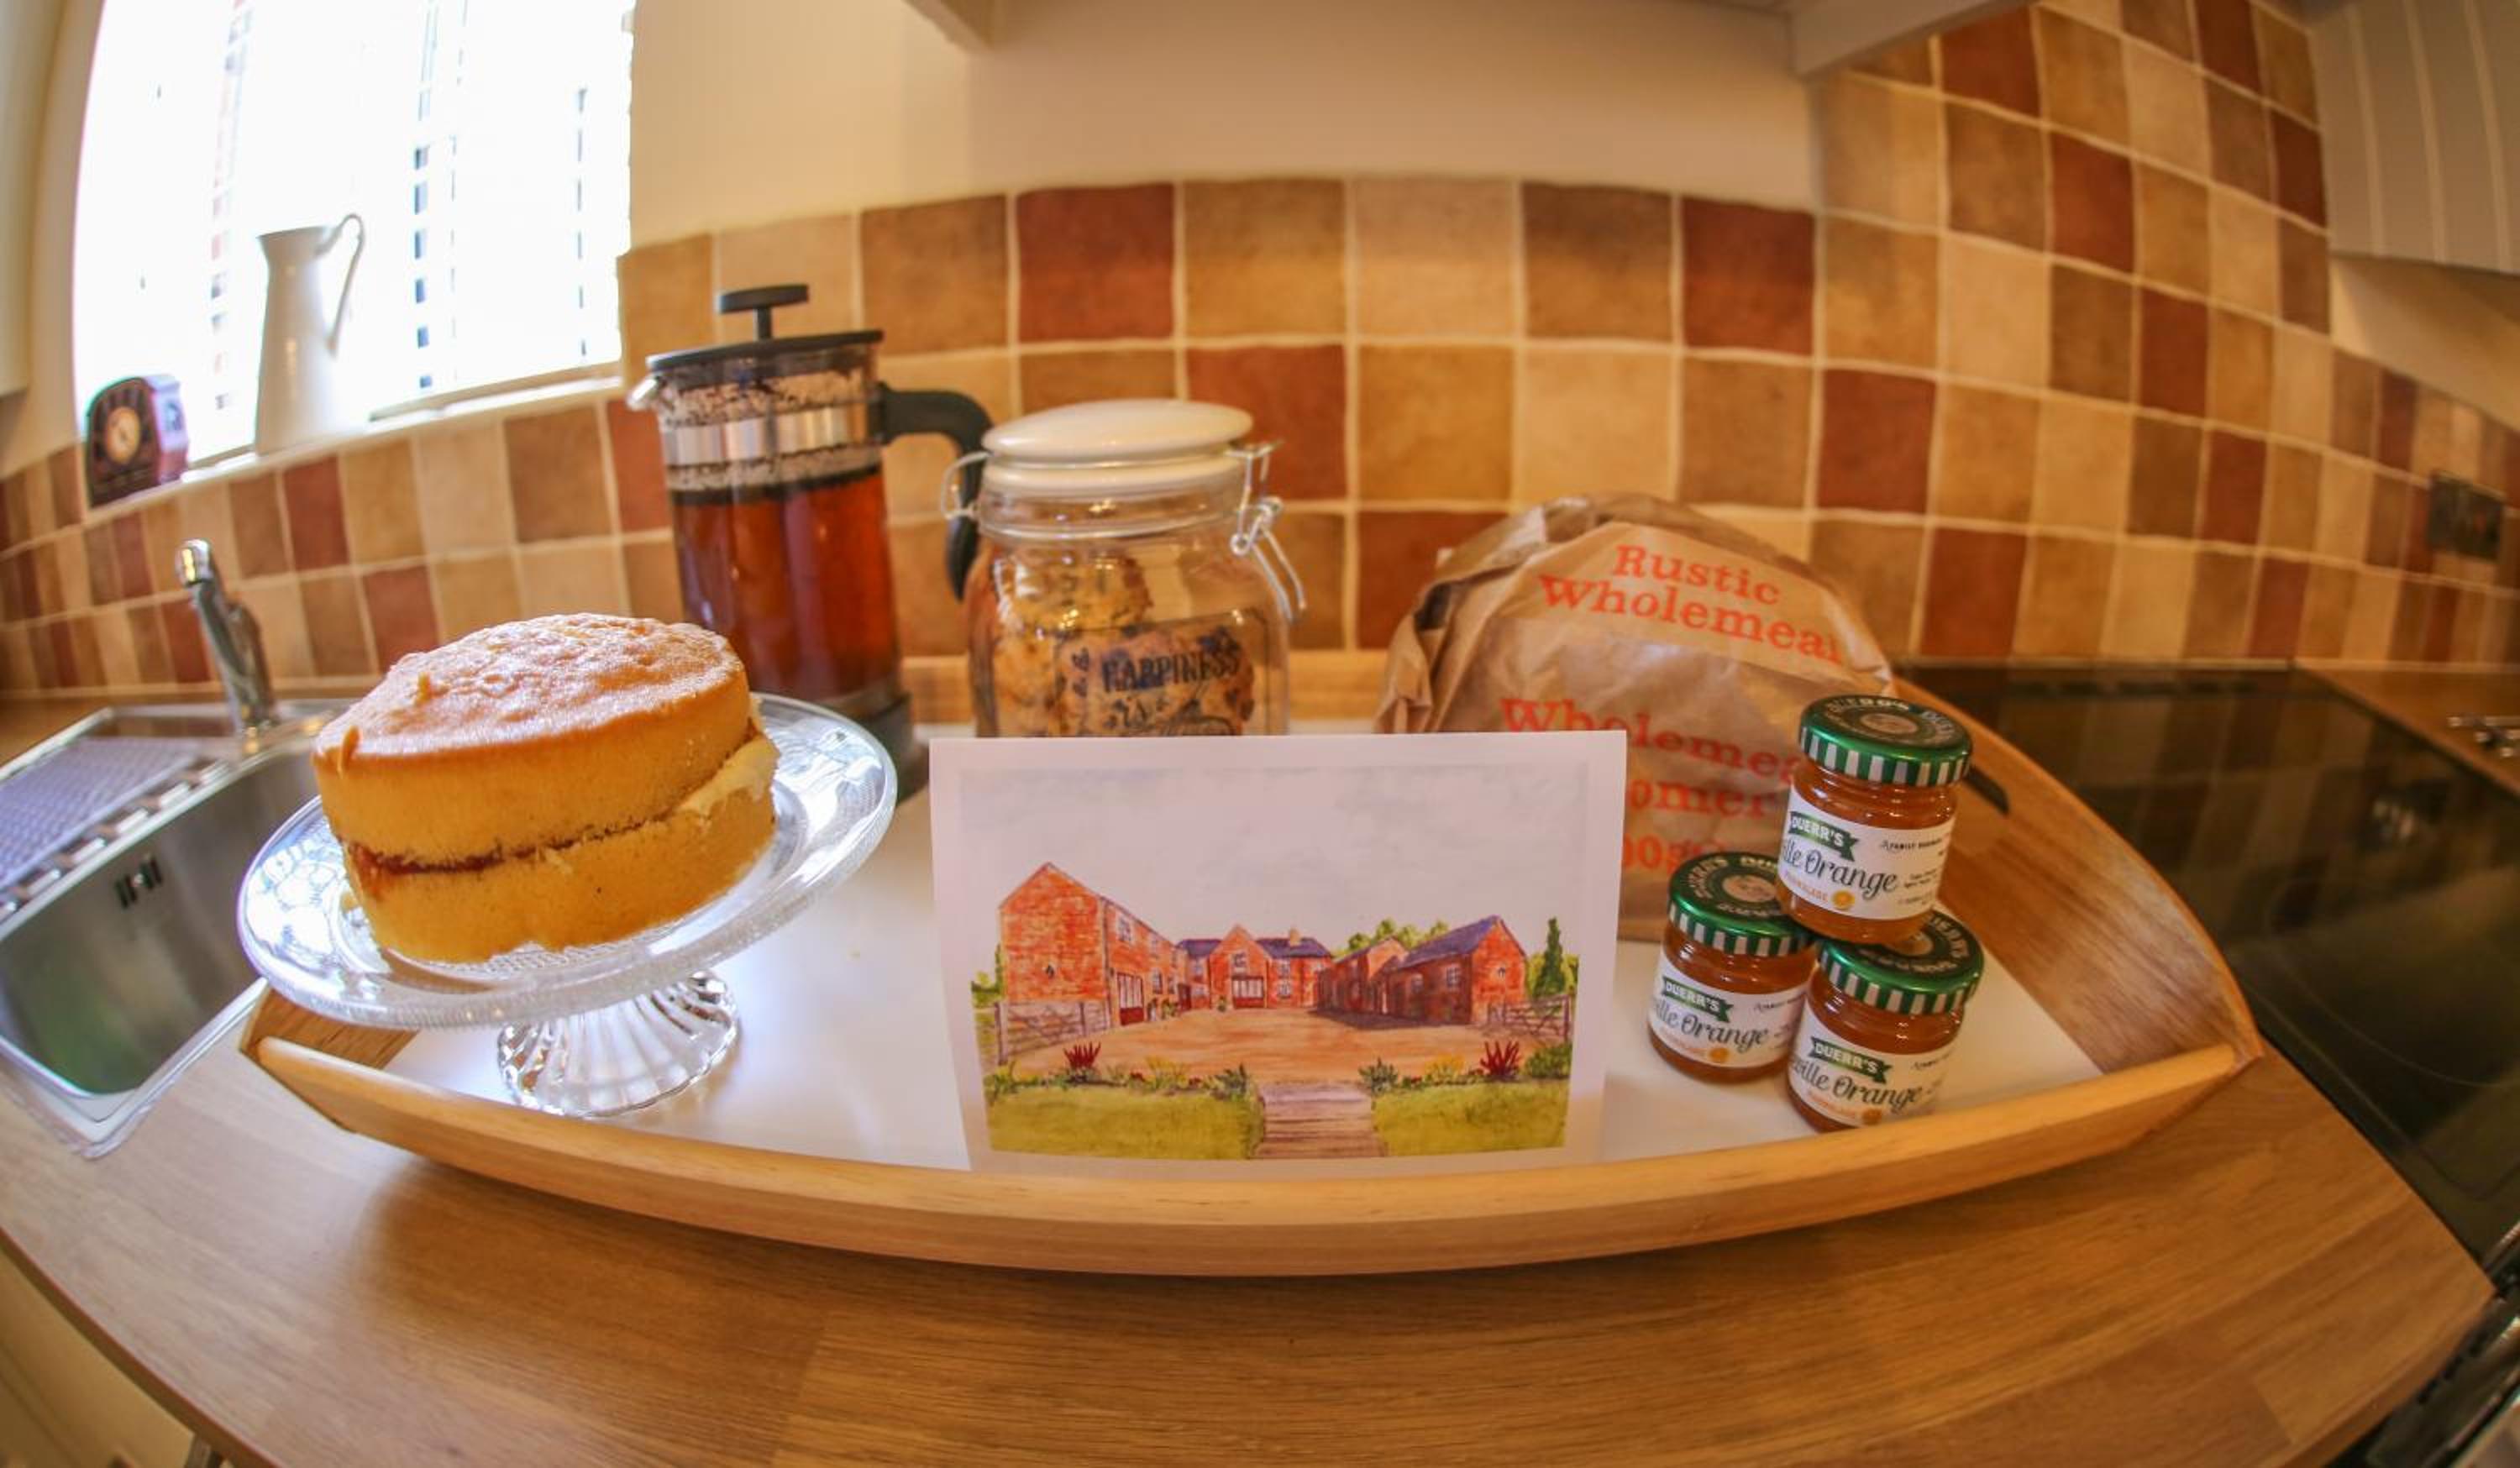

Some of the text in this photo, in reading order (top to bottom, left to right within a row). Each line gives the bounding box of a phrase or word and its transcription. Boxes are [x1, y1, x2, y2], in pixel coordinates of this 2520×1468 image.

[1612, 545, 1780, 606] Rustic
[1538, 574, 1843, 664] Wholemeal
[1629, 779, 1782, 820] omer
[1791, 815, 1845, 847] DUERR'S
[1805, 848, 1898, 901] Orange
[1665, 981, 1721, 1013] DUERR'S
[1681, 1013, 1769, 1055] Orange
[1814, 1041, 1878, 1075] DUERR'S
